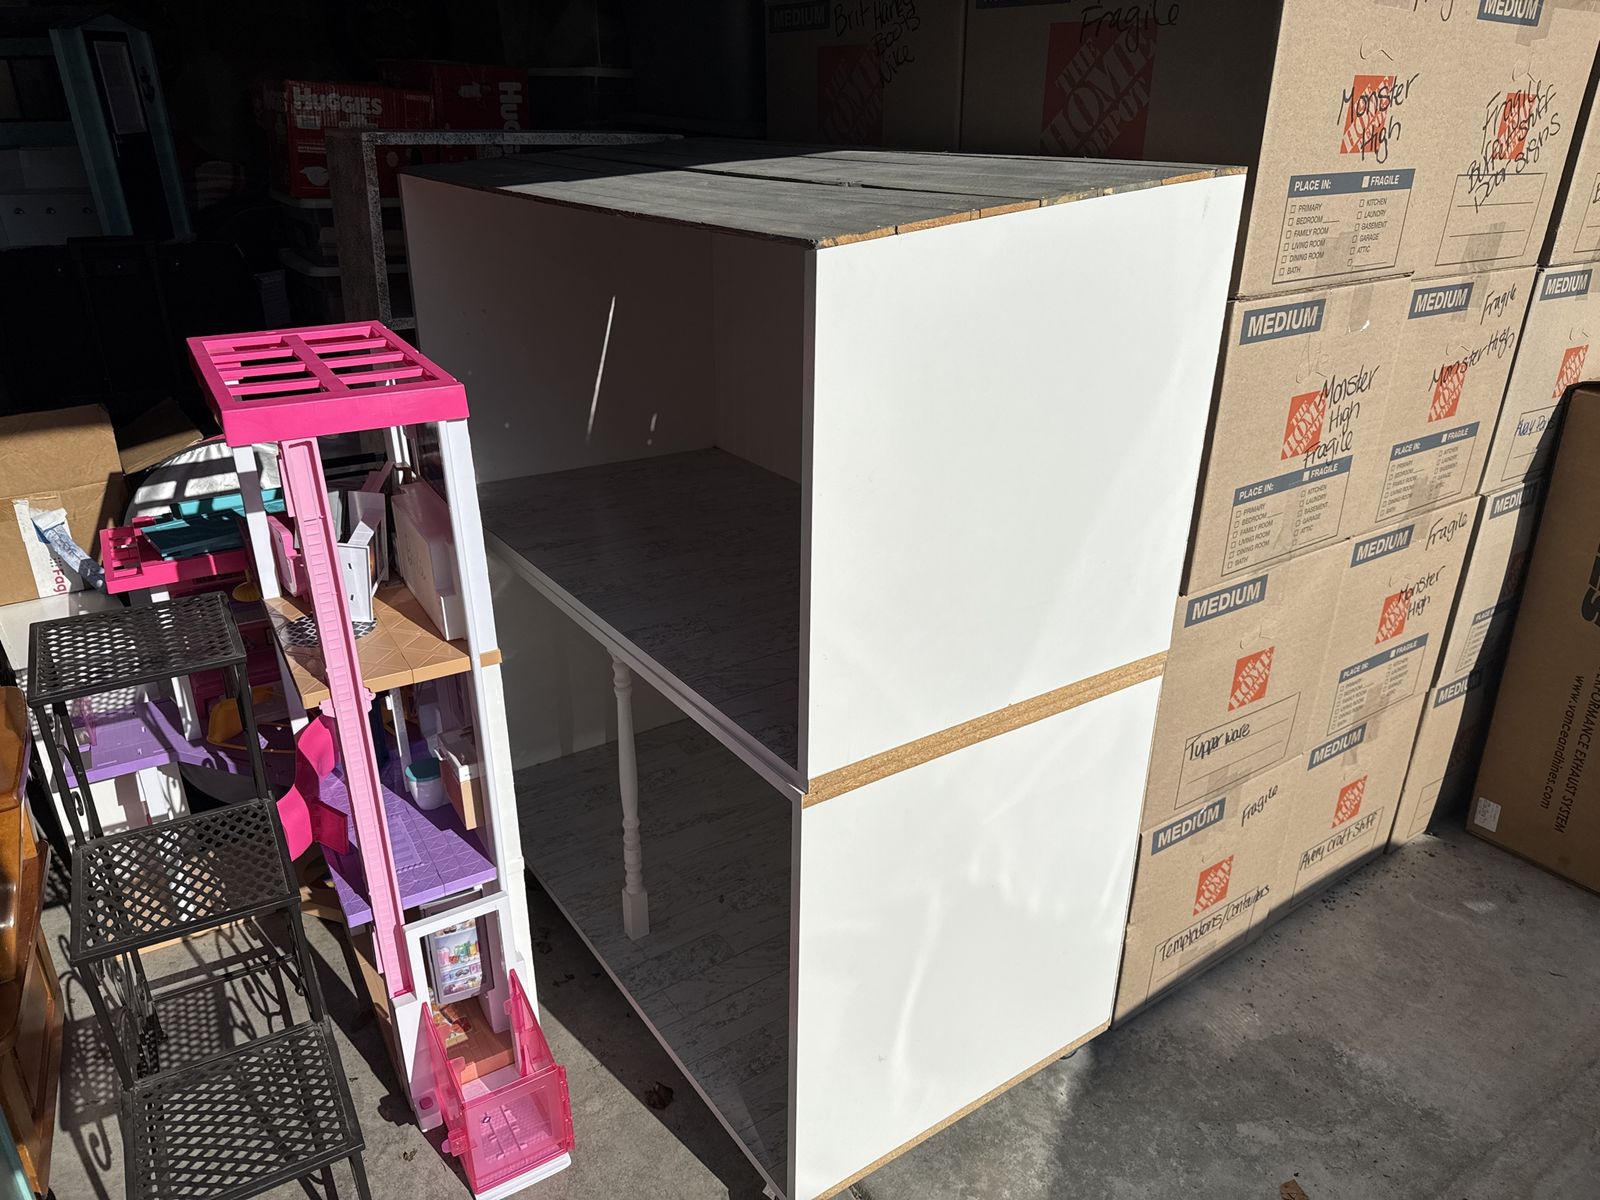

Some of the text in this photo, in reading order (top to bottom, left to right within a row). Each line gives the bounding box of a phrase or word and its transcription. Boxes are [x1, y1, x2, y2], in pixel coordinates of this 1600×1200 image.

[773, 4, 825, 27] MEDIUM
[1080, 0, 1180, 52] Fragile
[1056, 39, 1101, 95] THE
[293, 86, 383, 115] HUGGIES
[1040, 34, 1156, 156] HOME
[1337, 73, 1420, 126] Monster
[1360, 116, 1402, 164] High
[1294, 179, 1332, 192] PLACE IN:
[1370, 174, 1401, 187] FRAGILE
[1298, 203, 1323, 213] PRIMARY
[1364, 209, 1387, 219] LAUNDRY
[1366, 197, 1388, 207] KITCHEN
[1294, 227, 1330, 238] FAMILY ROOM
[1296, 215, 1323, 226] BEDROOM
[1361, 220, 1388, 231] BASEMENT
[1292, 239, 1327, 251] LIVING ROOM
[1357, 245, 1371, 254] ATTIC
[1359, 233, 1380, 243] GARAGE
[1287, 266, 1301, 275] BATH
[1289, 251, 1325, 263] DINING ROOM
[1545, 273, 1589, 296] MEDIUM
[1414, 288, 1469, 313] MEDIUM
[1480, 283, 1517, 325] Fragile
[1247, 306, 1319, 338] MEDIUM
[1428, 345, 1487, 392] Monster
[1487, 326, 1515, 360] High
[1318, 364, 1380, 409] Monster
[1329, 401, 1361, 437] High
[1447, 428, 1469, 440] FRAGILE
[1303, 430, 1353, 469] Fragile
[1394, 443, 1412, 456] PLACE
[1310, 463, 1339, 479] FRAGILE
[1239, 485, 1263, 500] PLACE
[1425, 511, 1468, 551] Fragile
[1356, 530, 1410, 562] MEDIUM
[52, 567, 68, 595] Fag
[1398, 565, 1446, 603] Monster
[1192, 581, 1262, 620] MEDIUM
[1407, 595, 1431, 621] High
[1313, 728, 1363, 765] MEDIUM
[1540, 674, 1585, 810] www.vanceandhines.com
[1565, 748, 1587, 797] EXHAUST
[1241, 785, 1278, 827] Fragile
[1554, 795, 1574, 834] SYSTEM
[1158, 803, 1221, 849] MEDIUM
